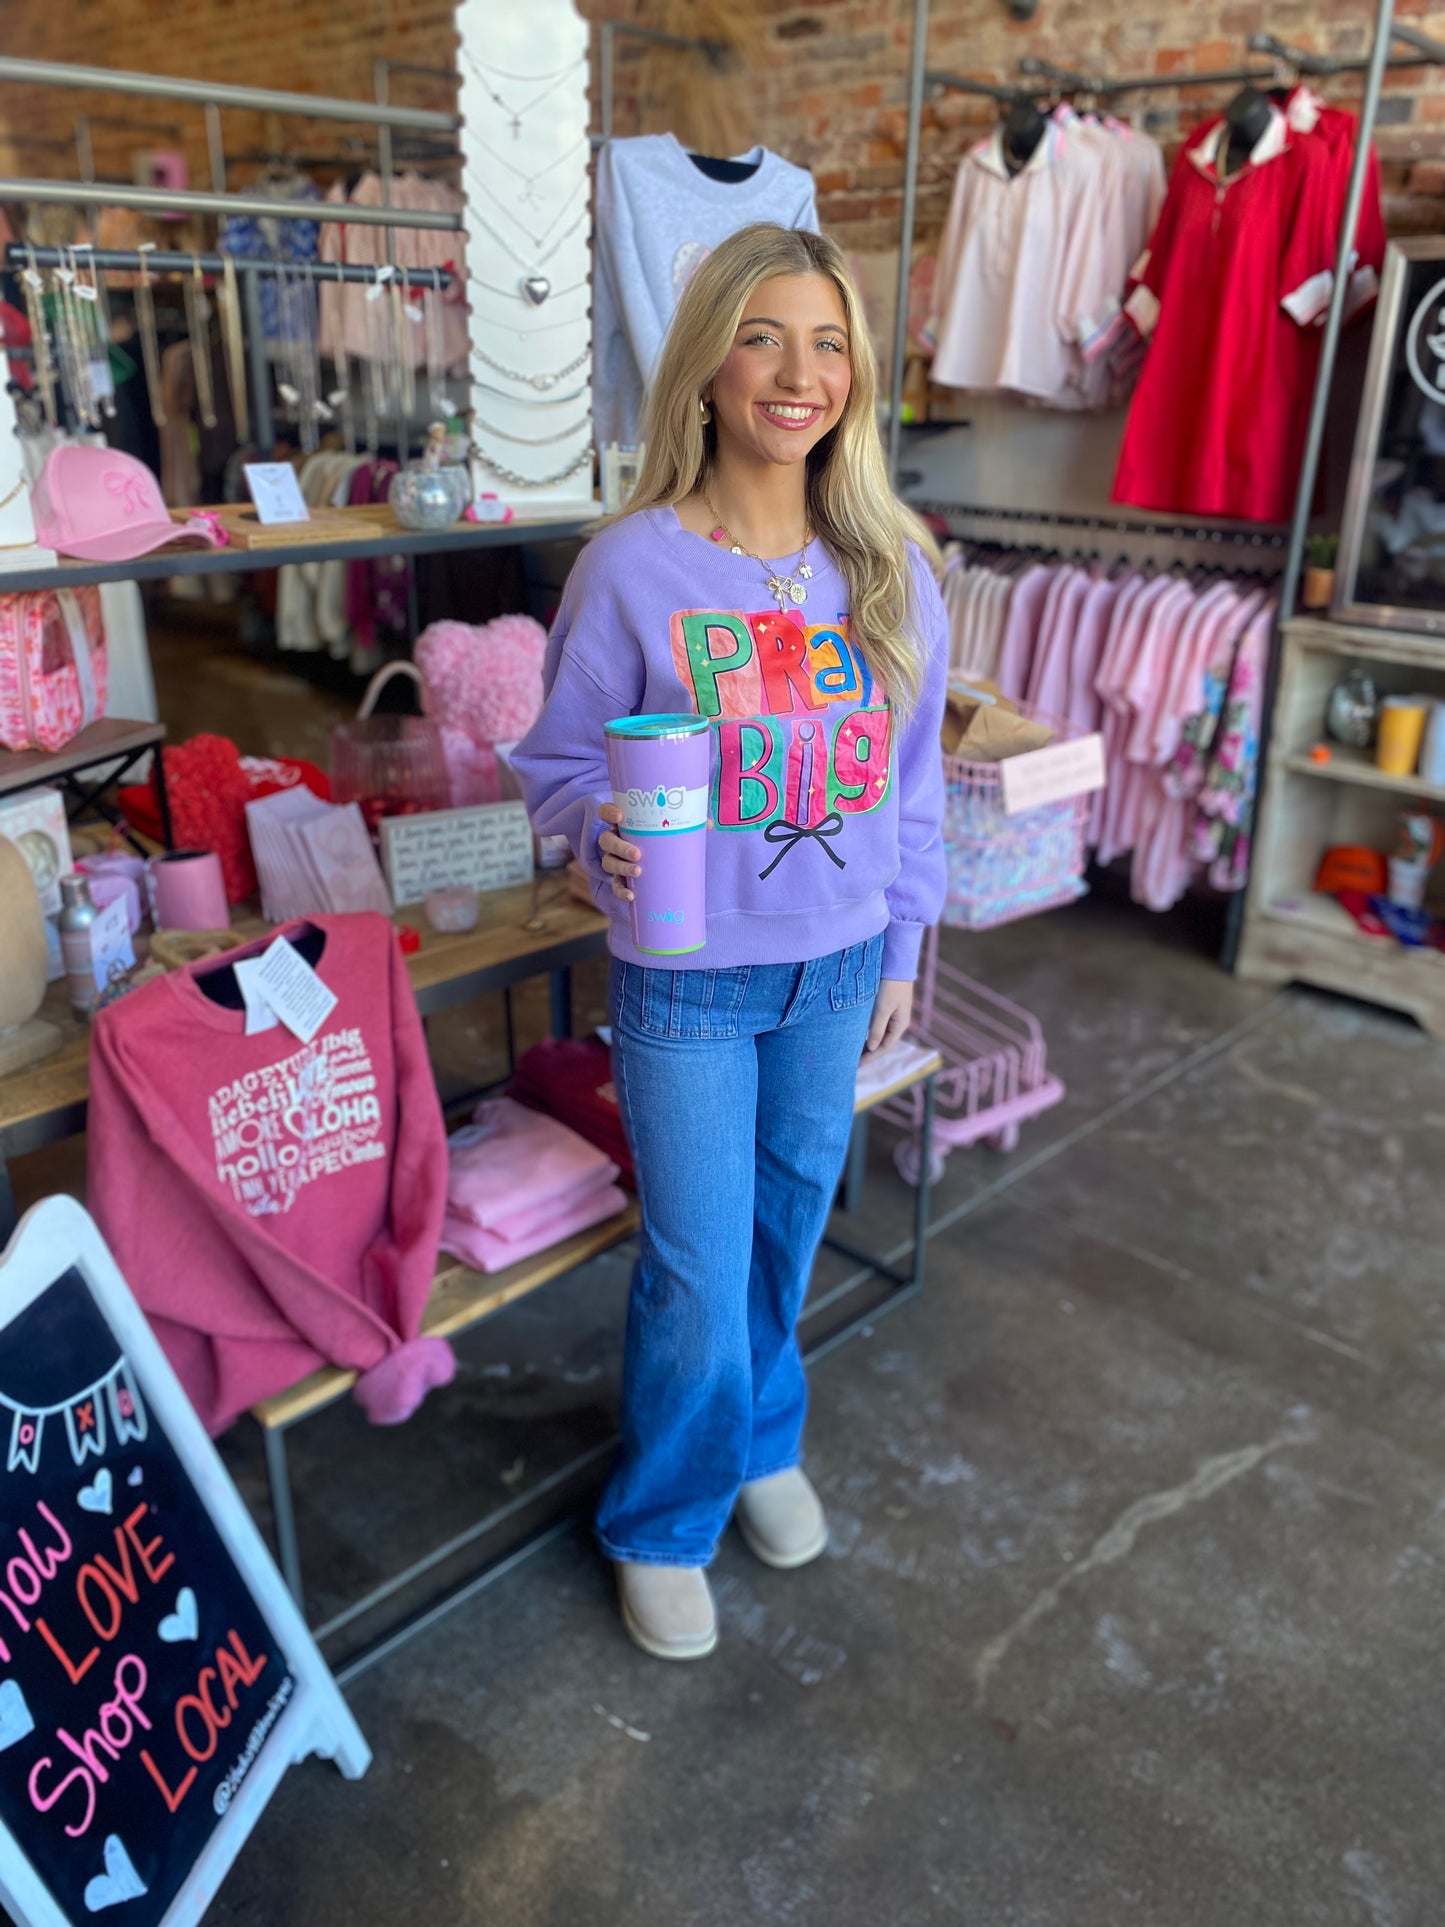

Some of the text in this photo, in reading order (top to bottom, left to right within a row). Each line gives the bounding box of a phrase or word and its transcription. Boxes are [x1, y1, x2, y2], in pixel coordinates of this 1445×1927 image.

[717, 707, 891, 828] Big
[34, 1501, 176, 1685] LOVE
[28, 1653, 152, 1837] Shop
[140, 1629, 268, 1813] LOCAL
